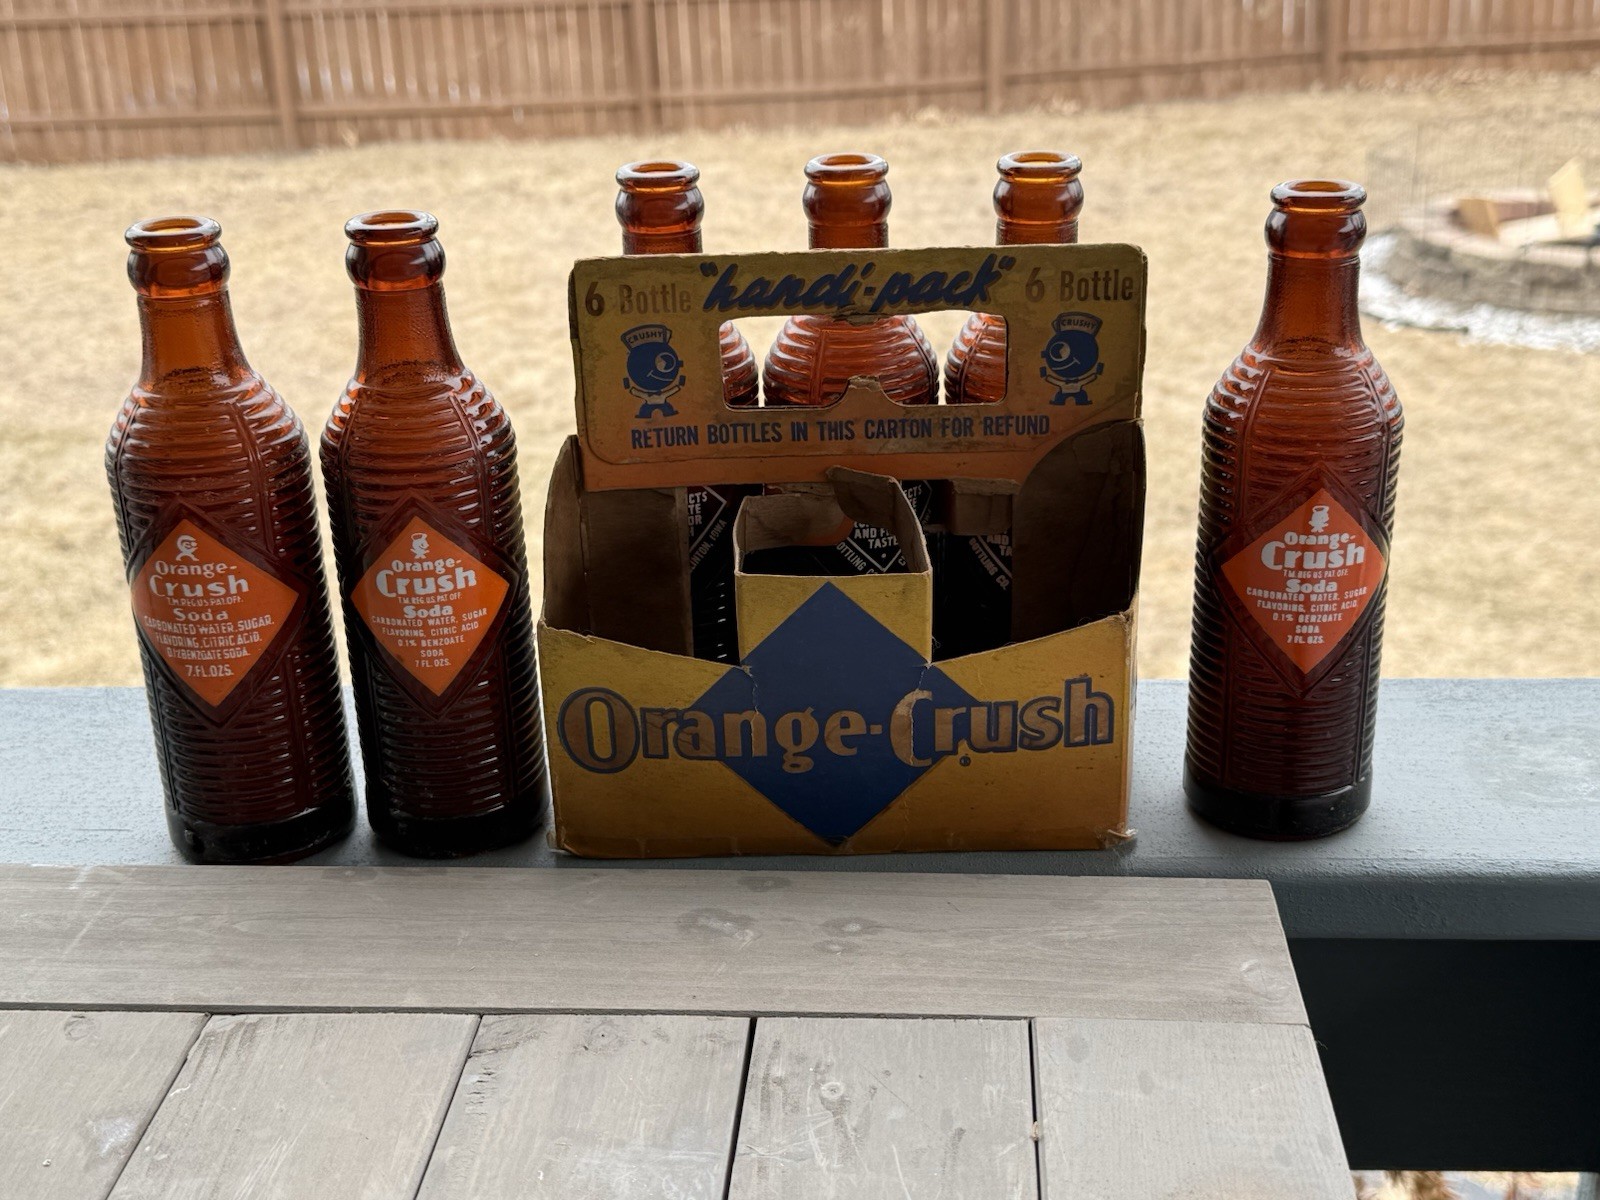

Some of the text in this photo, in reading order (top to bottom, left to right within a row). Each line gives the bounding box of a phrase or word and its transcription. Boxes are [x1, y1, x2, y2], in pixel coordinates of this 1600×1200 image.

[584, 280, 605, 317] 6
[617, 283, 693, 315] Bottle
[1024, 266, 1046, 303] 6
[1059, 268, 1134, 301] Bottle
[1060, 318, 1097, 331] CRUSHY
[628, 330, 664, 344] CRUSHY
[631, 414, 1051, 450] RETURN BOTTLES IN THIS CARTON FOR REFUND
[853, 527, 878, 541] AND
[836, 541, 867, 572] OTTLING
[1260, 540, 1366, 571] Crush
[149, 574, 250, 598] Crush
[375, 566, 478, 598] Crush
[1285, 578, 1338, 594] Soda
[1246, 586, 1306, 602] CARBONATED
[172, 607, 229, 621] Soda
[402, 604, 454, 619] Soda
[1310, 603, 1338, 613] CITRIC
[371, 615, 423, 627] CARBONATED
[462, 607, 488, 621] SUGAR
[1297, 612, 1344, 624] BENZOATE
[143, 615, 197, 635] CARBONATED
[430, 626, 458, 637] CITRIC
[1295, 624, 1321, 634] SODA
[203, 633, 235, 648] CITRIC
[420, 634, 466, 648] BENZOATE
[420, 648, 444, 658] SODA
[557, 675, 1115, 773] Orange-Crush
